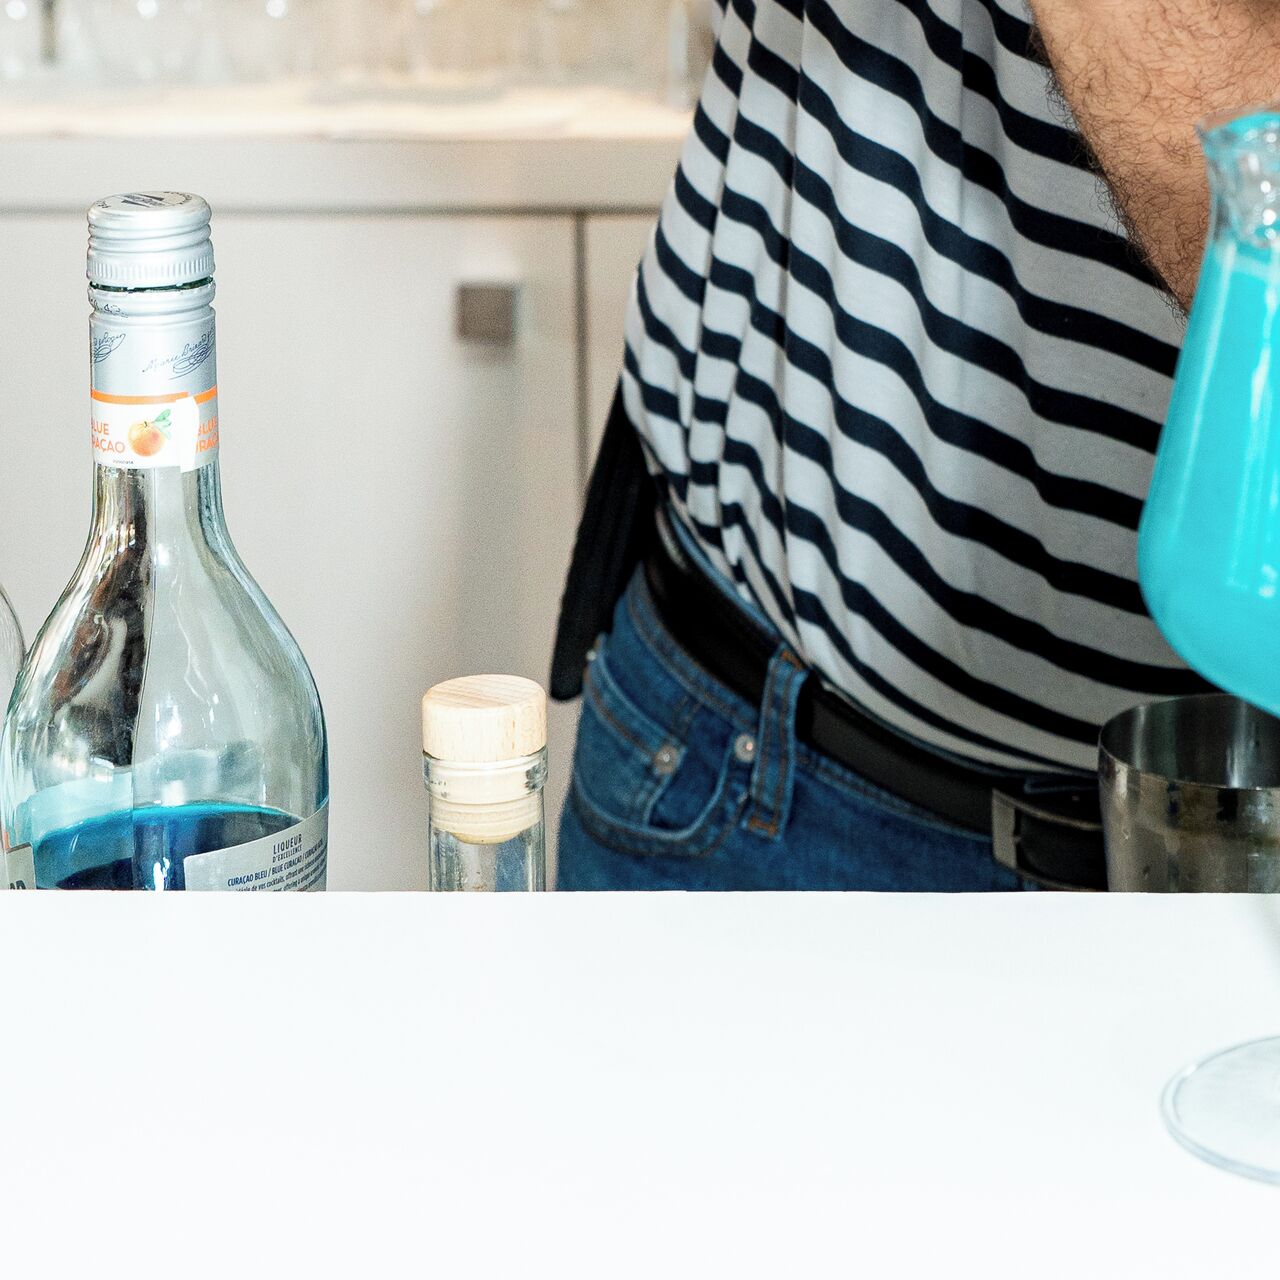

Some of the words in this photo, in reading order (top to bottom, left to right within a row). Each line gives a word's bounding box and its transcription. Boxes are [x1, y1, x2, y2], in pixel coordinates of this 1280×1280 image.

[272, 844, 302, 863] D'EXCELLENCE
[273, 834, 302, 855] LIQUEUR
[227, 873, 254, 887] CURAÇAO
[254, 869, 268, 881] BLEU
[271, 863, 284, 876] BLUE
